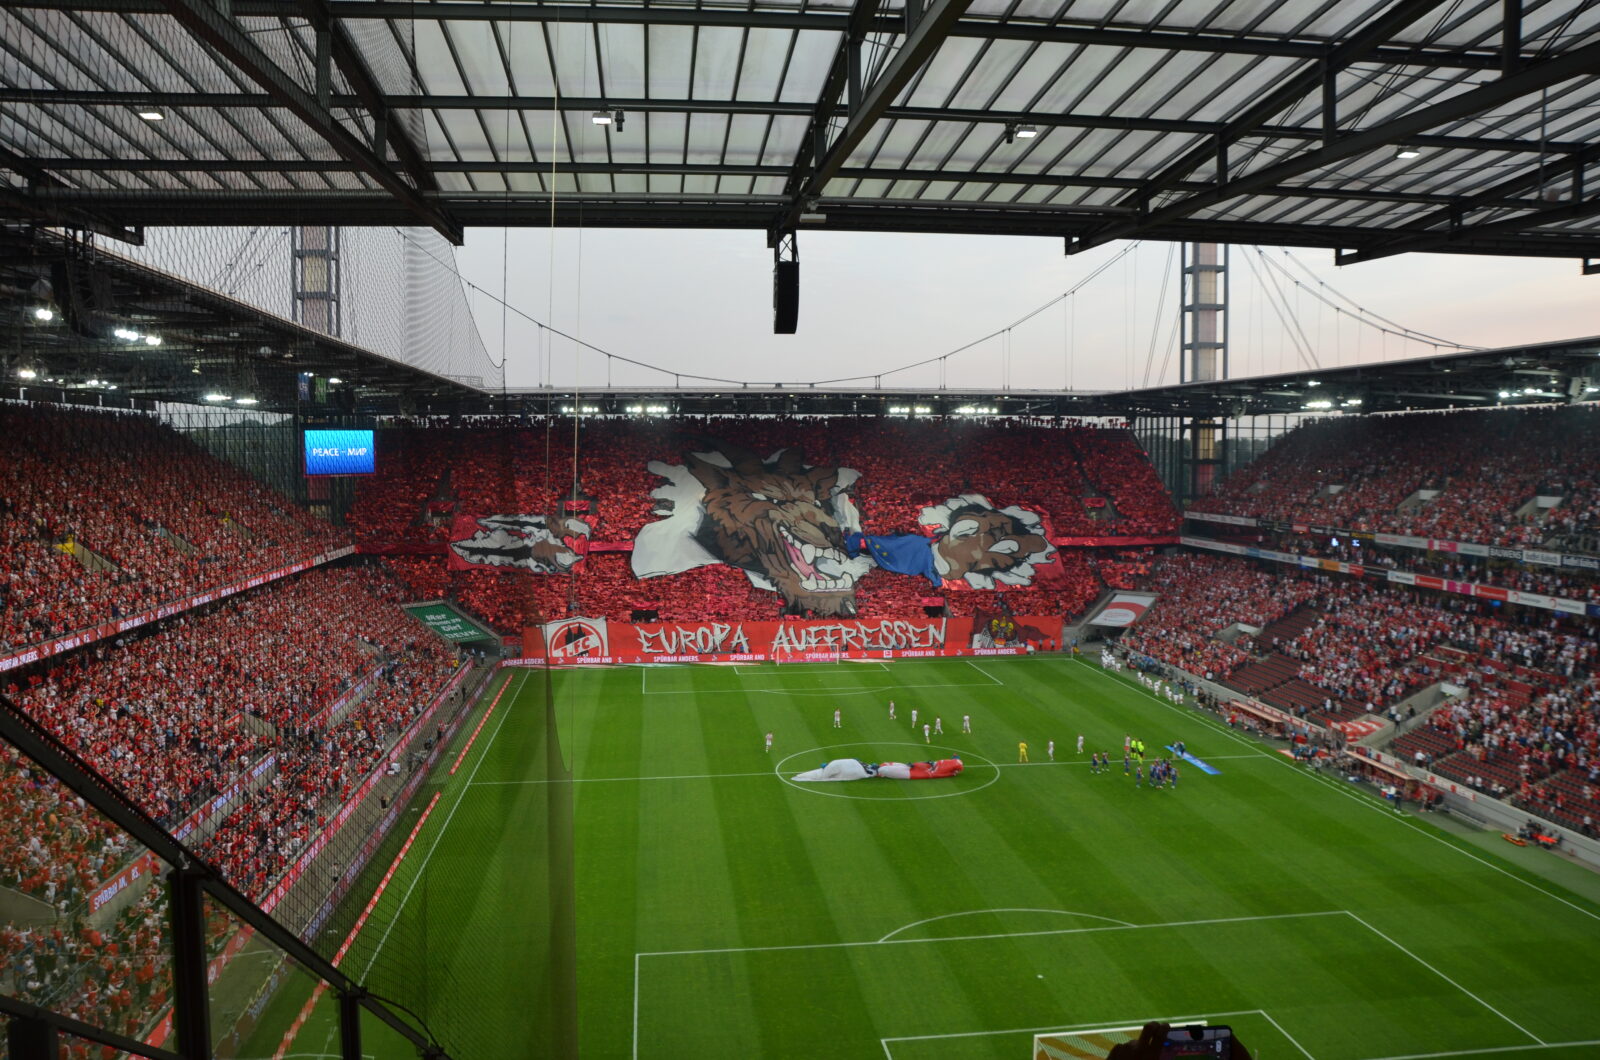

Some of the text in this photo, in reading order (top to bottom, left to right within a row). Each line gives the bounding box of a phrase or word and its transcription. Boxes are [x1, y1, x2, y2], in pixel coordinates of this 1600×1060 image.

[312, 447, 340, 457] PEACE
[347, 447, 367, 456] МИР
[635, 622, 749, 654] EUROPA
[653, 655, 677, 663] SPÜRBAR
